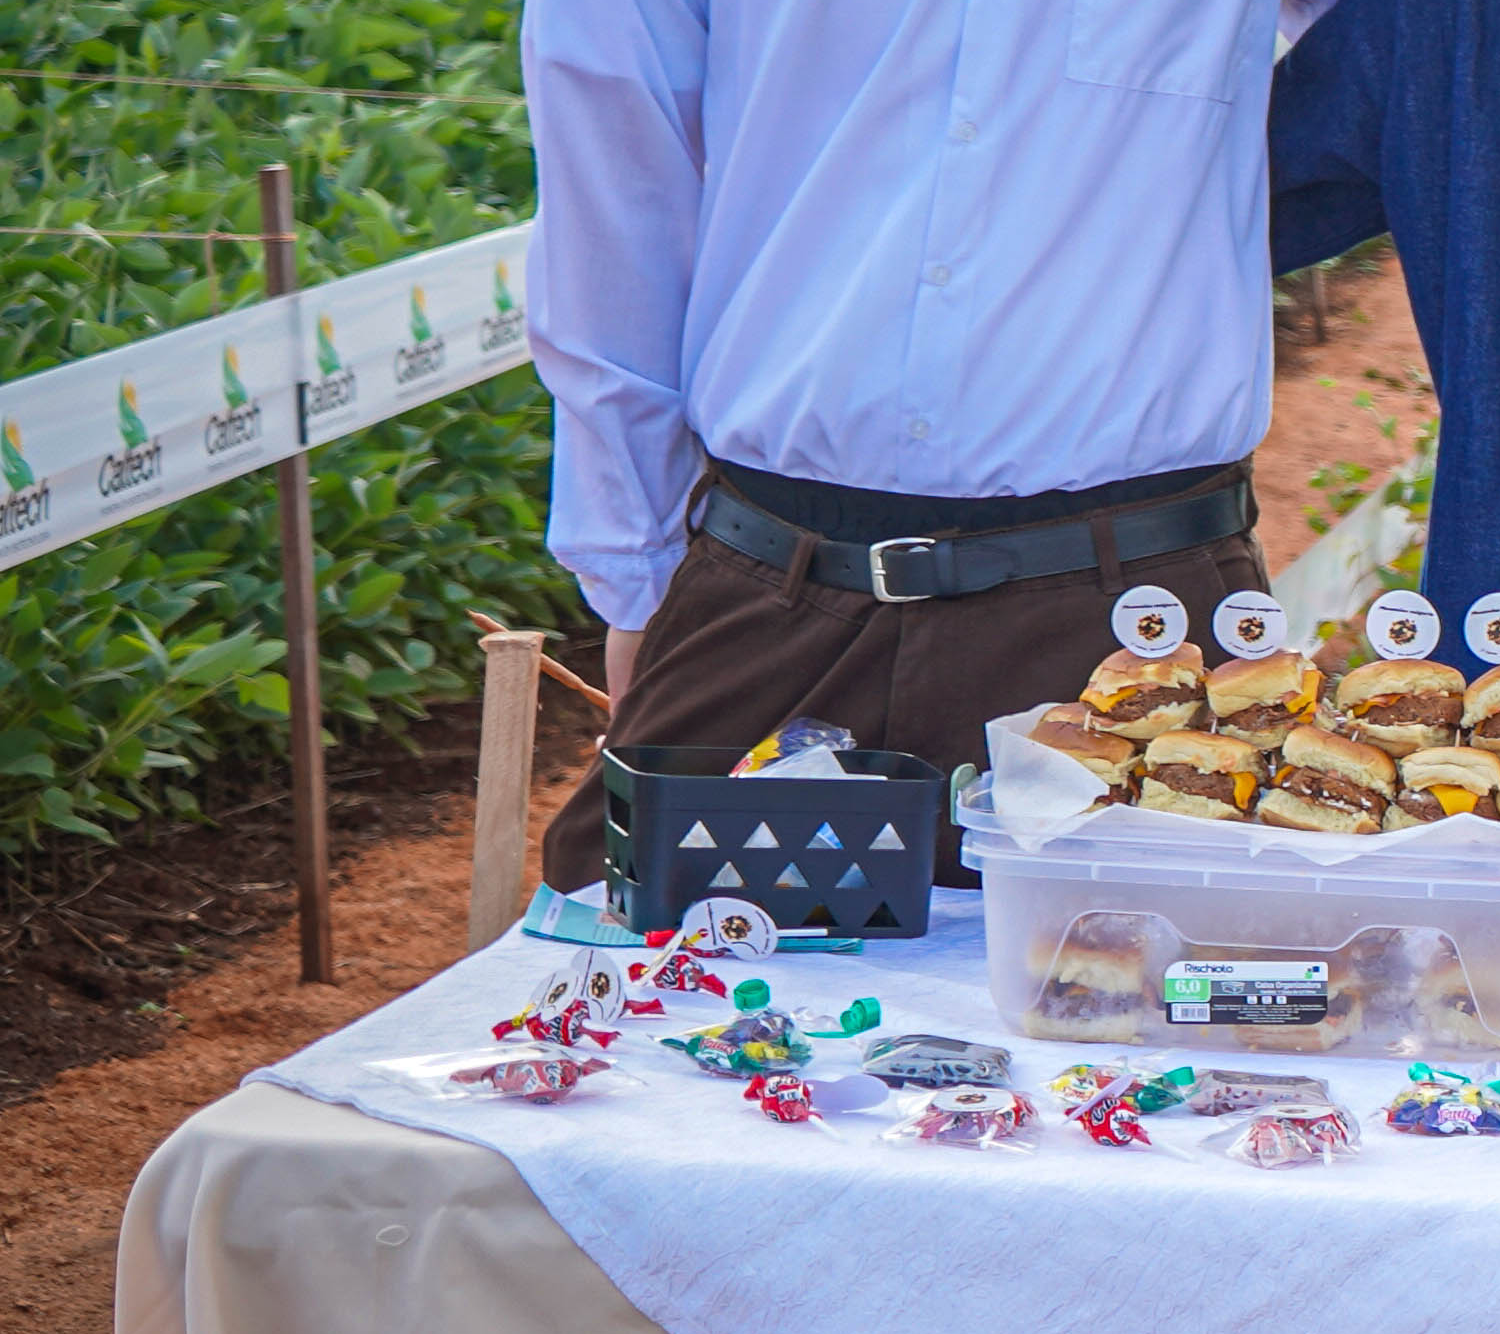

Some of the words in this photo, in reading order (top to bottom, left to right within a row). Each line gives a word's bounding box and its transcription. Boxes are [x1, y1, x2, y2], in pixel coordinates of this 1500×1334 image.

[205, 397, 262, 455] Caltech
[99, 436, 163, 498] Caltech
[0, 478, 50, 539] altech
[1174, 979, 1201, 994] 6,0
